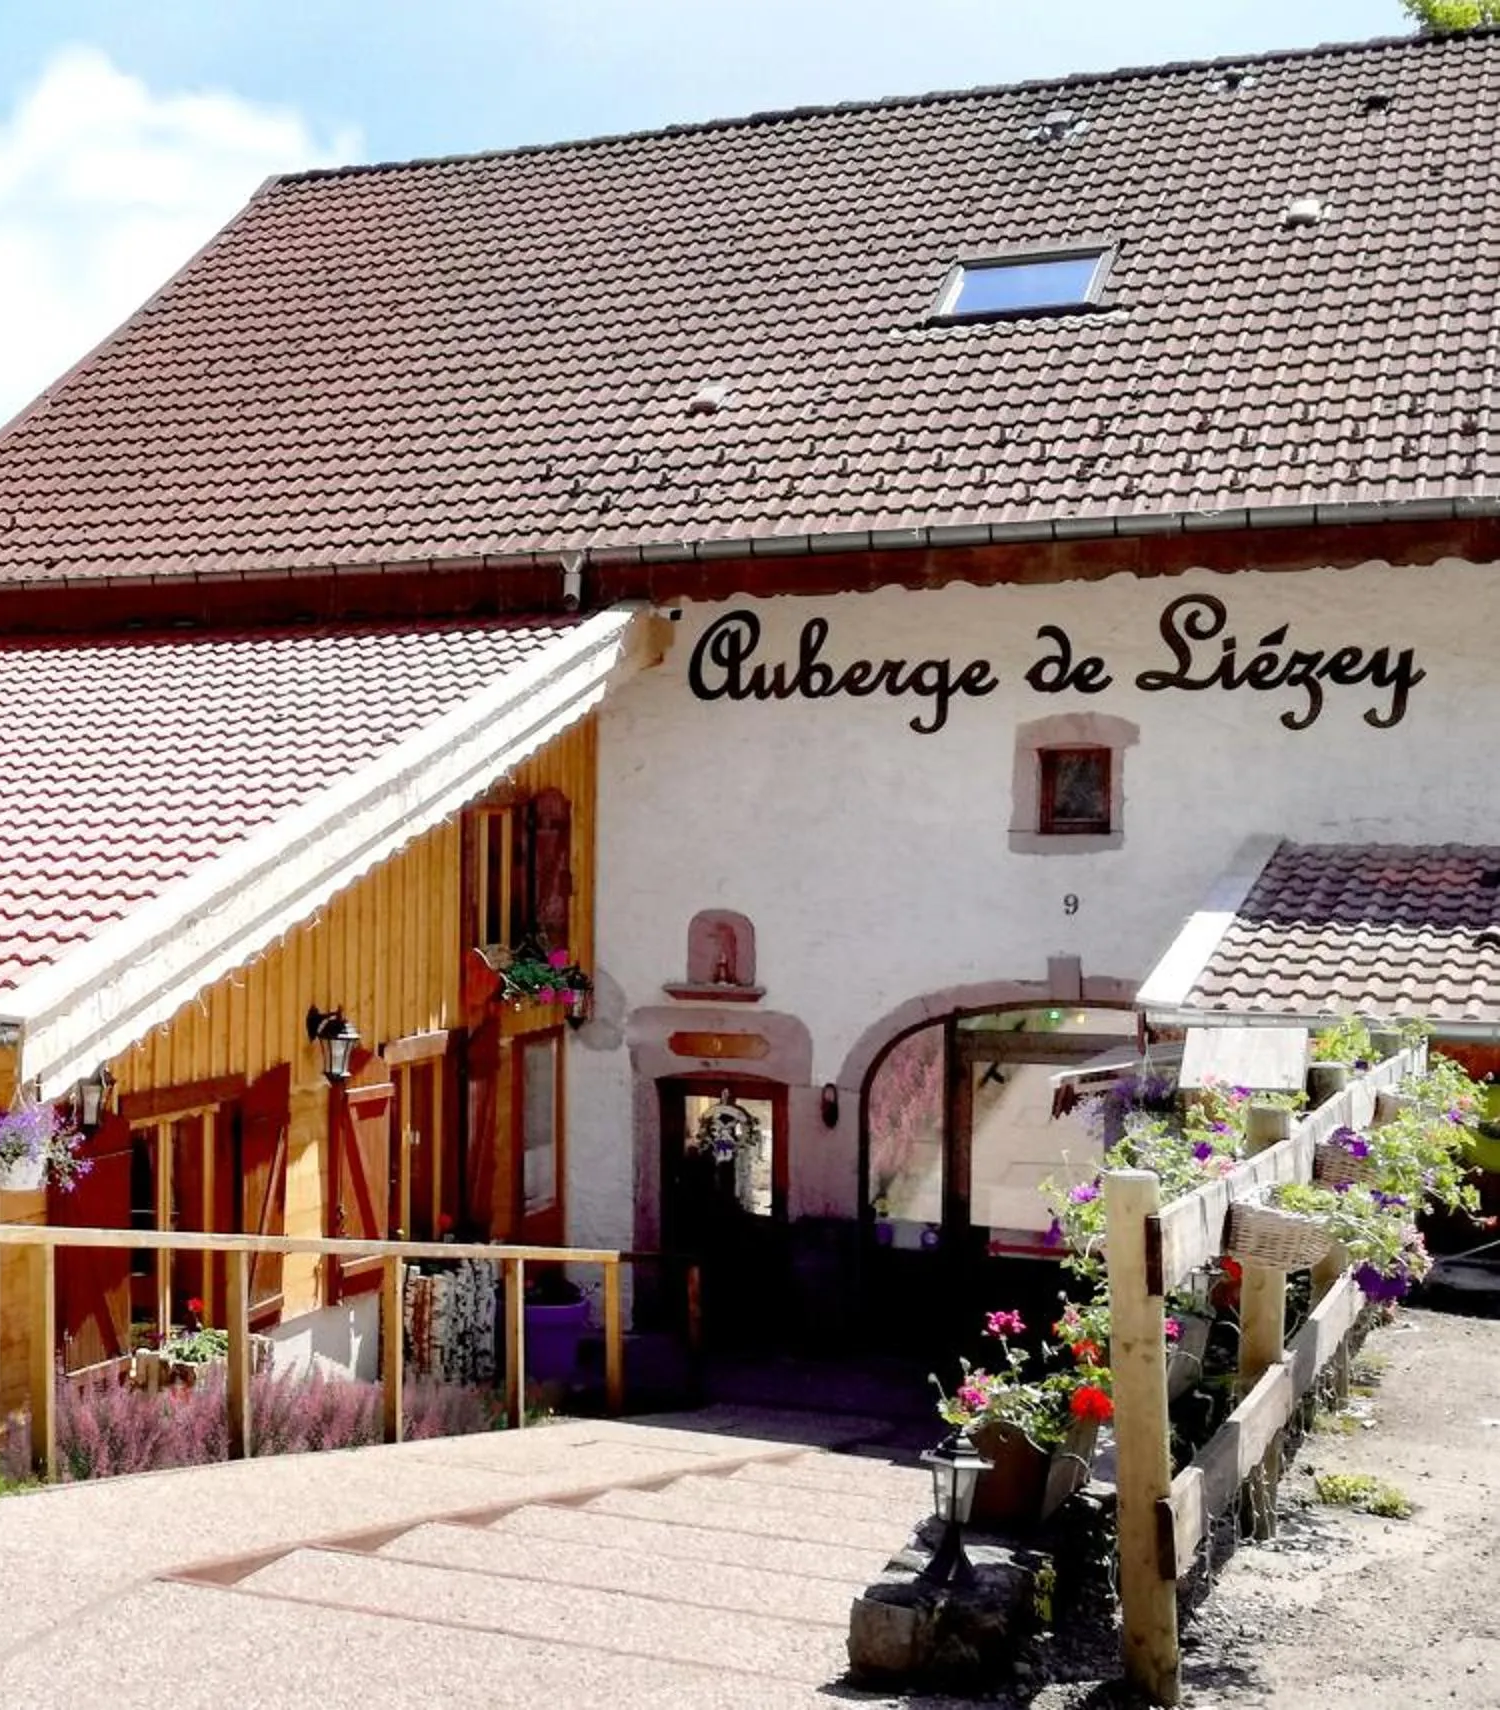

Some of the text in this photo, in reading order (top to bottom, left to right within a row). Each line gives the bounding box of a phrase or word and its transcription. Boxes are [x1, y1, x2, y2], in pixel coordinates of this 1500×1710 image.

[688, 593, 1427, 735] Auberge de Liézey
[1063, 893, 1080, 916] 9
